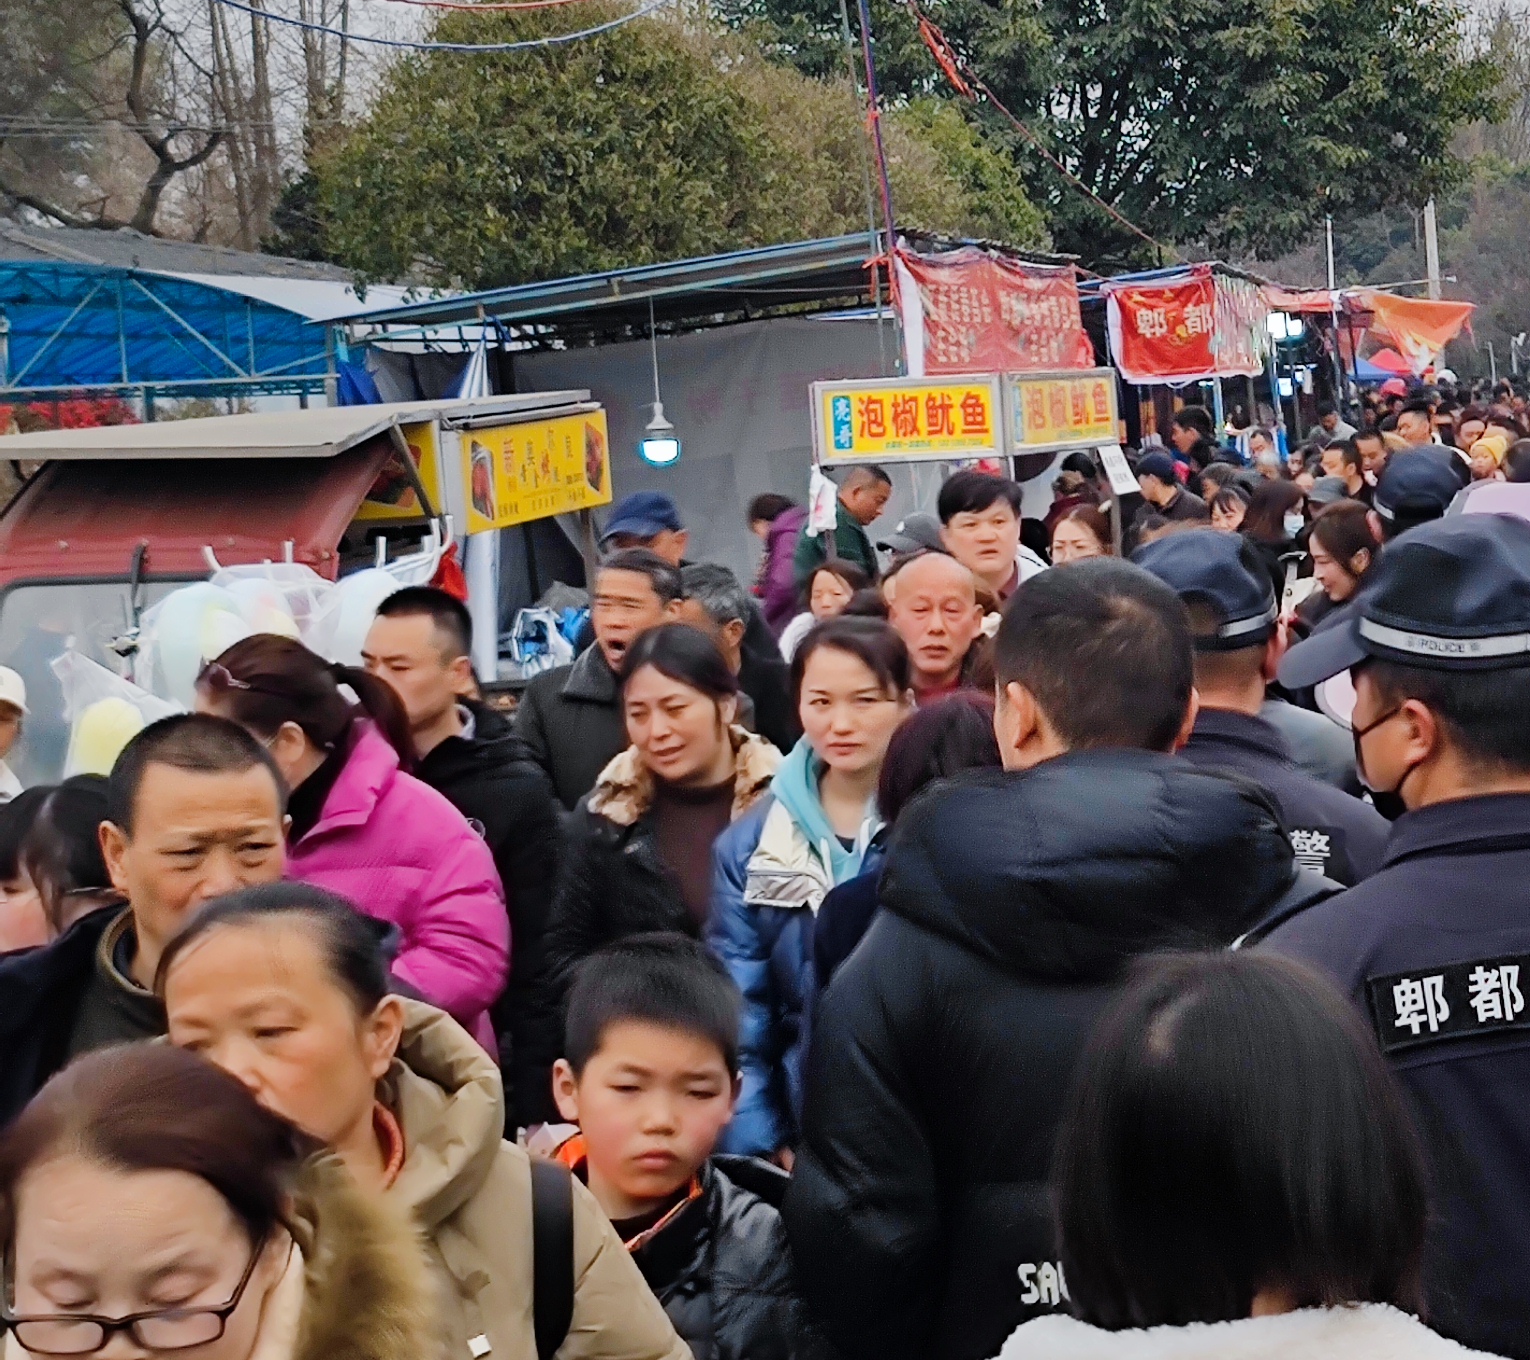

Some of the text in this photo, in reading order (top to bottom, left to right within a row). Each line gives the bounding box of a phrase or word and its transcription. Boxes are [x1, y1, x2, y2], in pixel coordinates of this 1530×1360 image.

[858, 390, 990, 439] 泡椒鱿鱼
[1420, 637, 1467, 654] POLICE
